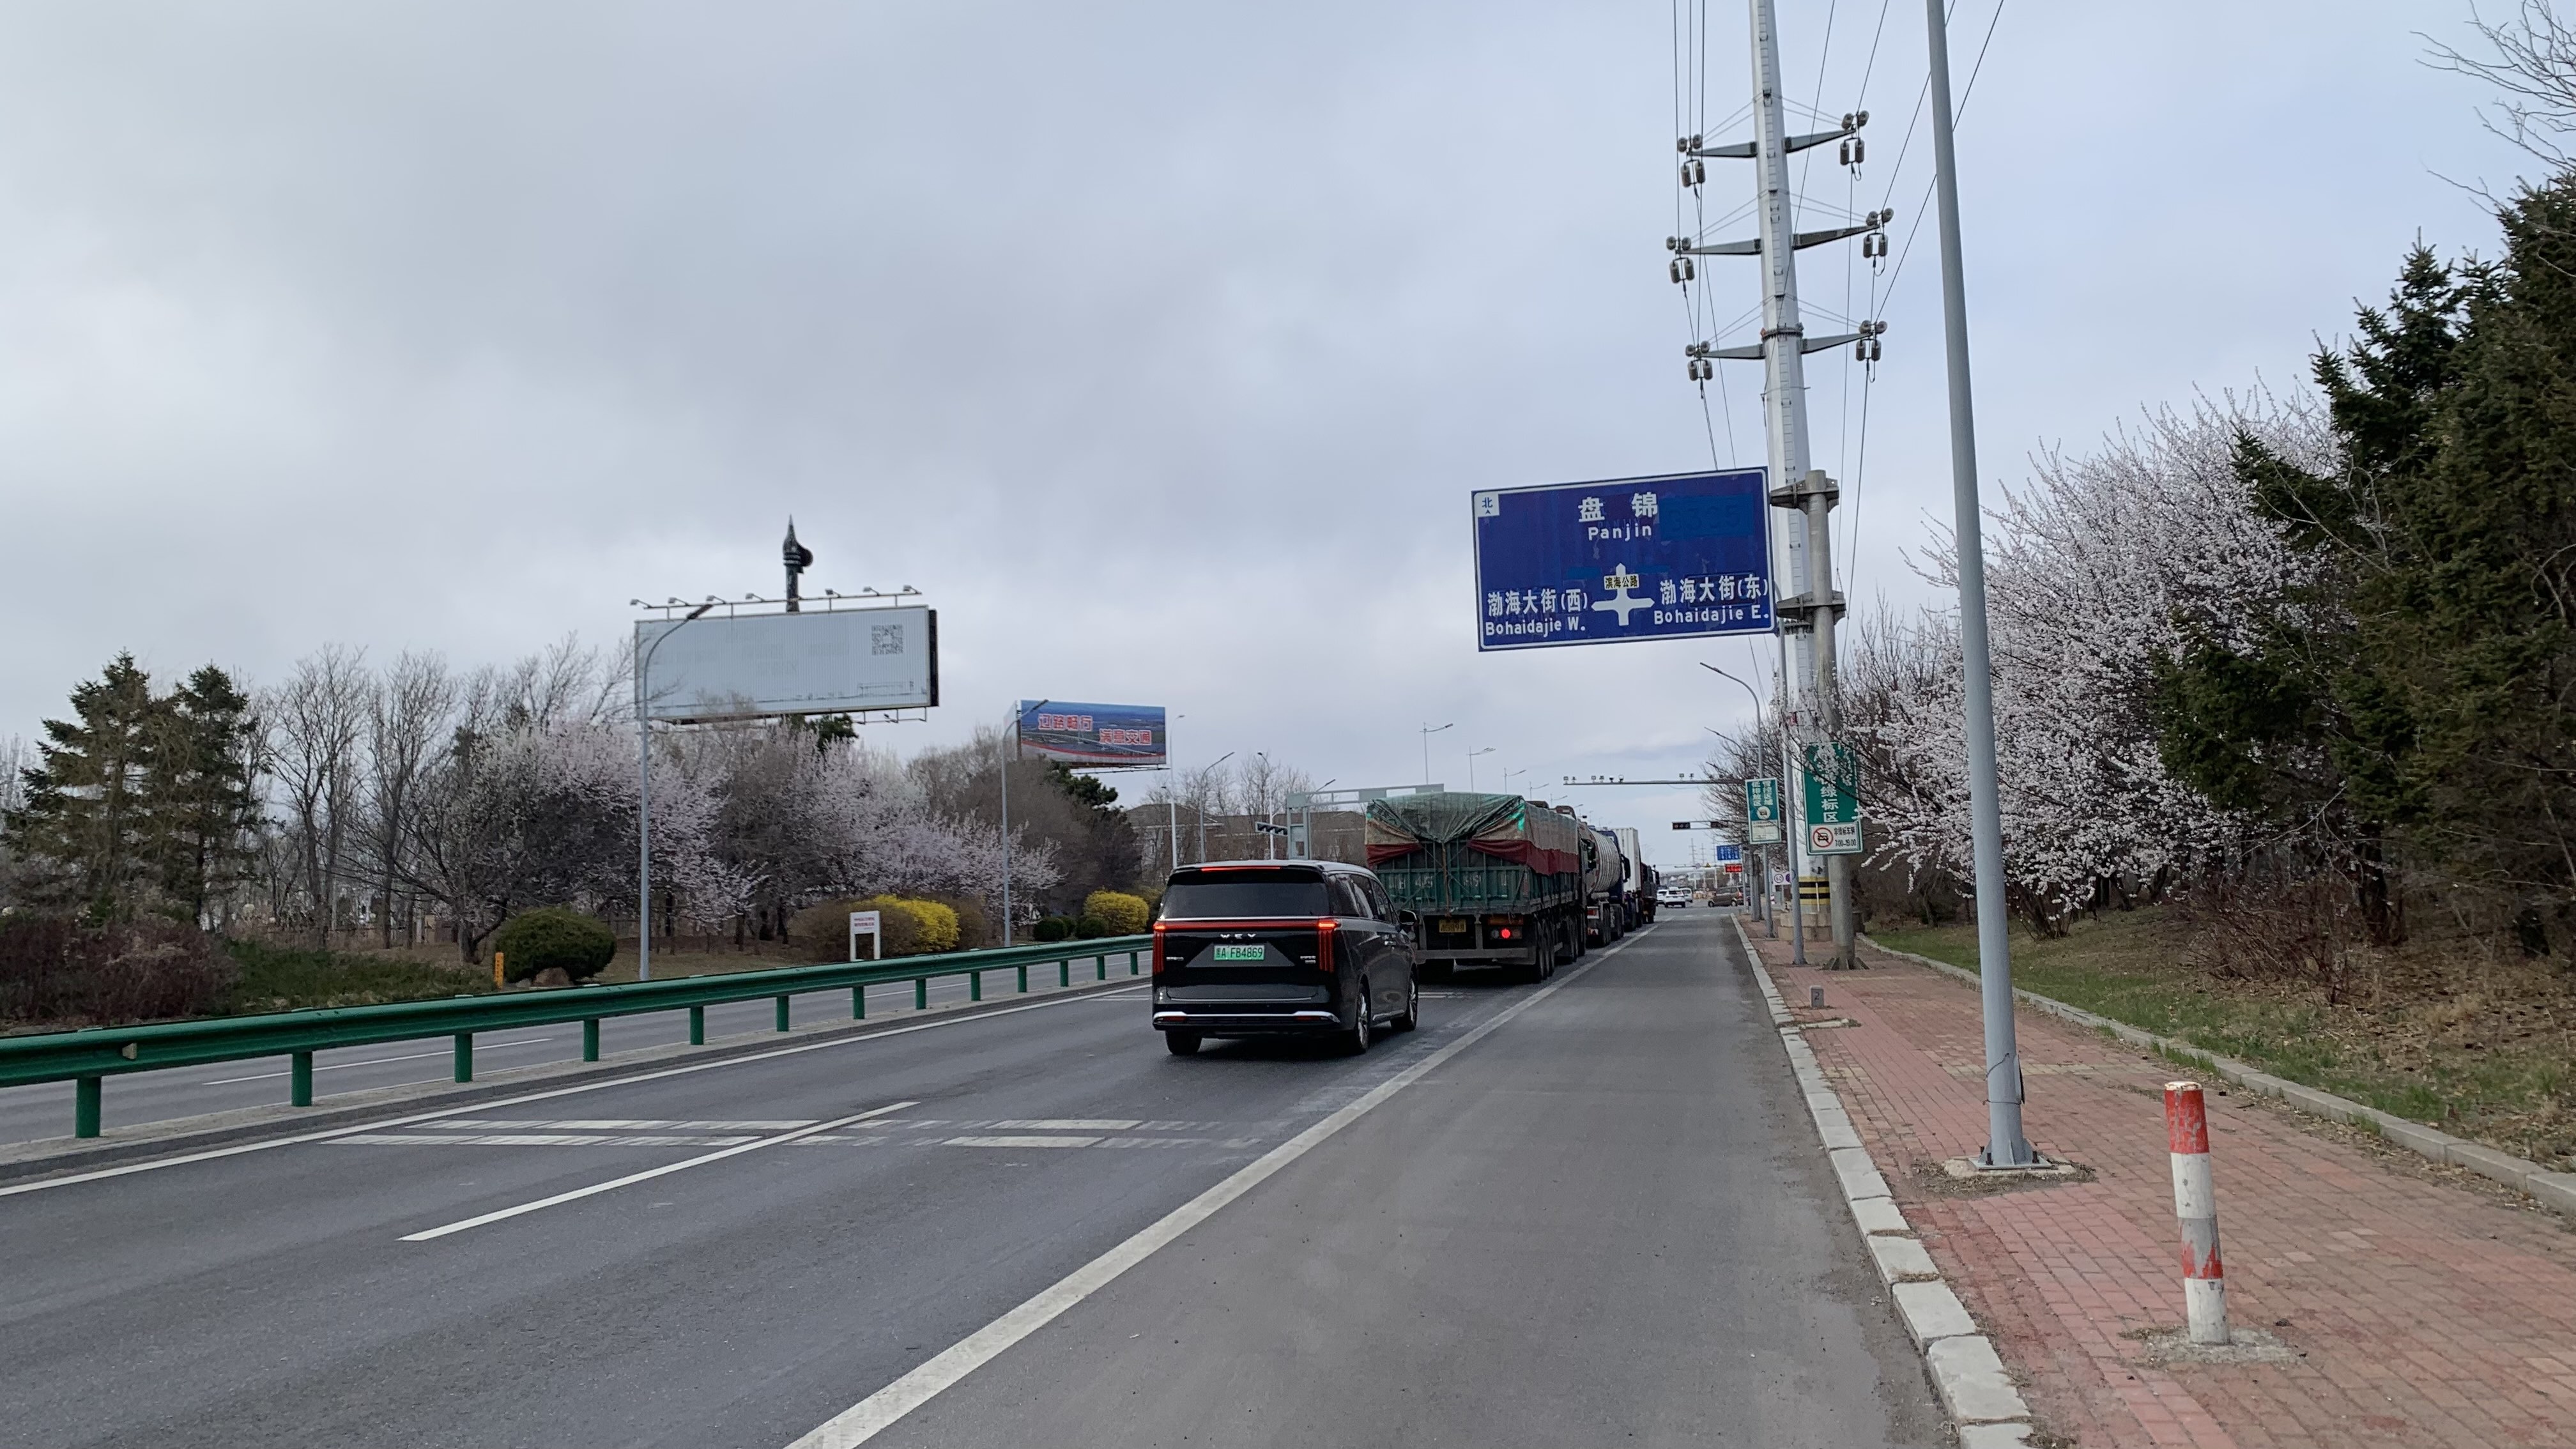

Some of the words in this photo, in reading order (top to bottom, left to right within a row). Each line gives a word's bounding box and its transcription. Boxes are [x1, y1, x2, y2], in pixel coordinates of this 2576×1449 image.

[1482, 497, 1493, 509] 北
[1588, 523, 1652, 542] Panjin
[1605, 575, 1638, 589] 滨海公路
[1653, 608, 1744, 625] Bohaidajie
[1752, 604, 1769, 619] E.
[1485, 620, 1561, 638] Bohaidajie
[1567, 616, 1586, 632] W.
